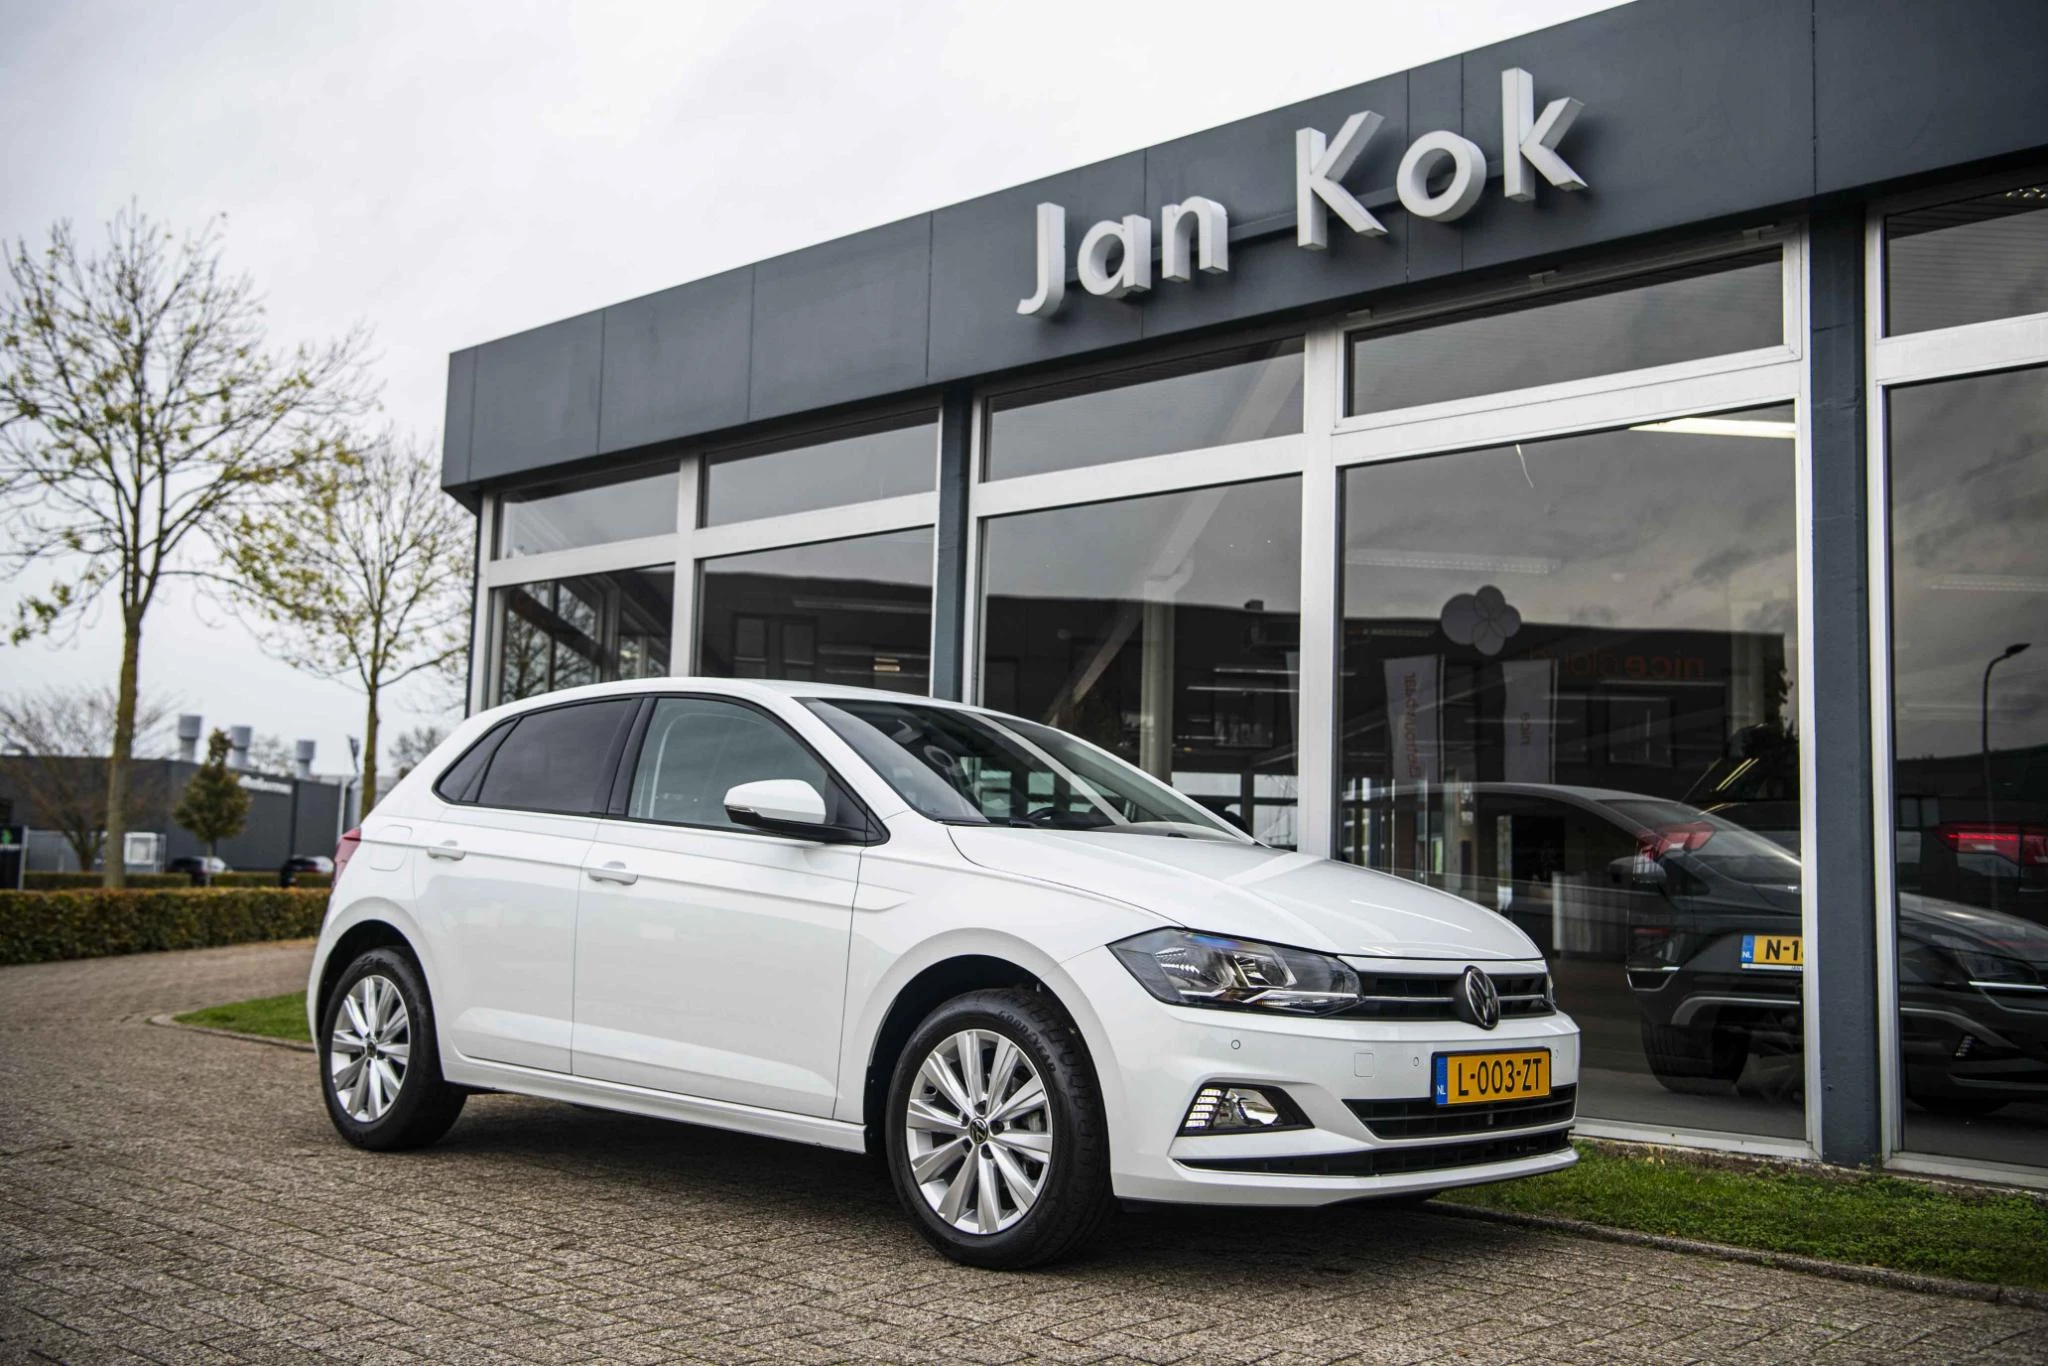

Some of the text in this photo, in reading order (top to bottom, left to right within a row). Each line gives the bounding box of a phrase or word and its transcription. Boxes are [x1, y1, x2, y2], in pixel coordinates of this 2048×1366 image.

[1016, 67, 1590, 318] Jan Kok
[1765, 938, 1804, 962] N-1
[1436, 1084, 1447, 1096] NL
[1458, 1058, 1542, 1097] L-003-ZT
